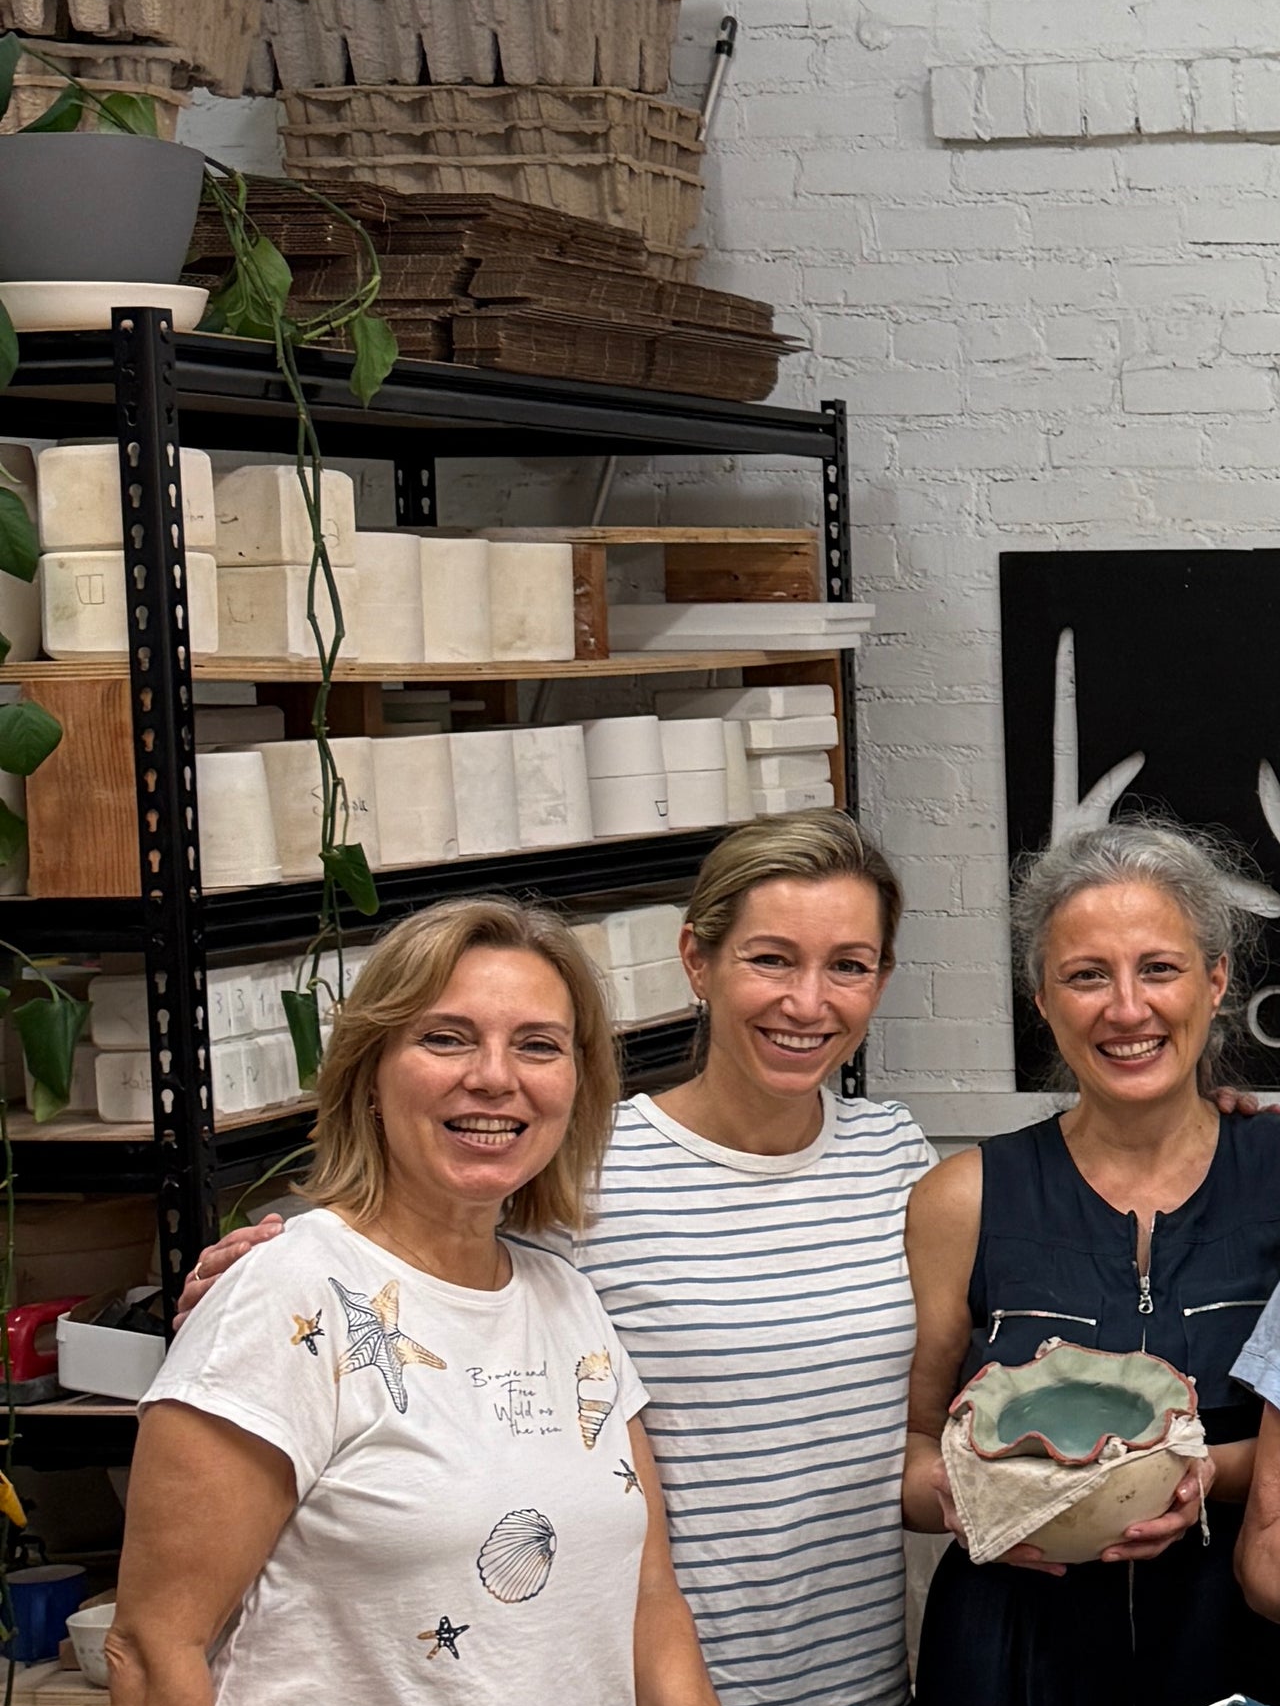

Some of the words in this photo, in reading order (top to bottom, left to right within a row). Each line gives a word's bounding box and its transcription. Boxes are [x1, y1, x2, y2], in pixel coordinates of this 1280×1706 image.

[525, 1360, 549, 1379] and
[493, 1399, 534, 1422] Wild
[509, 1419, 534, 1437] the
